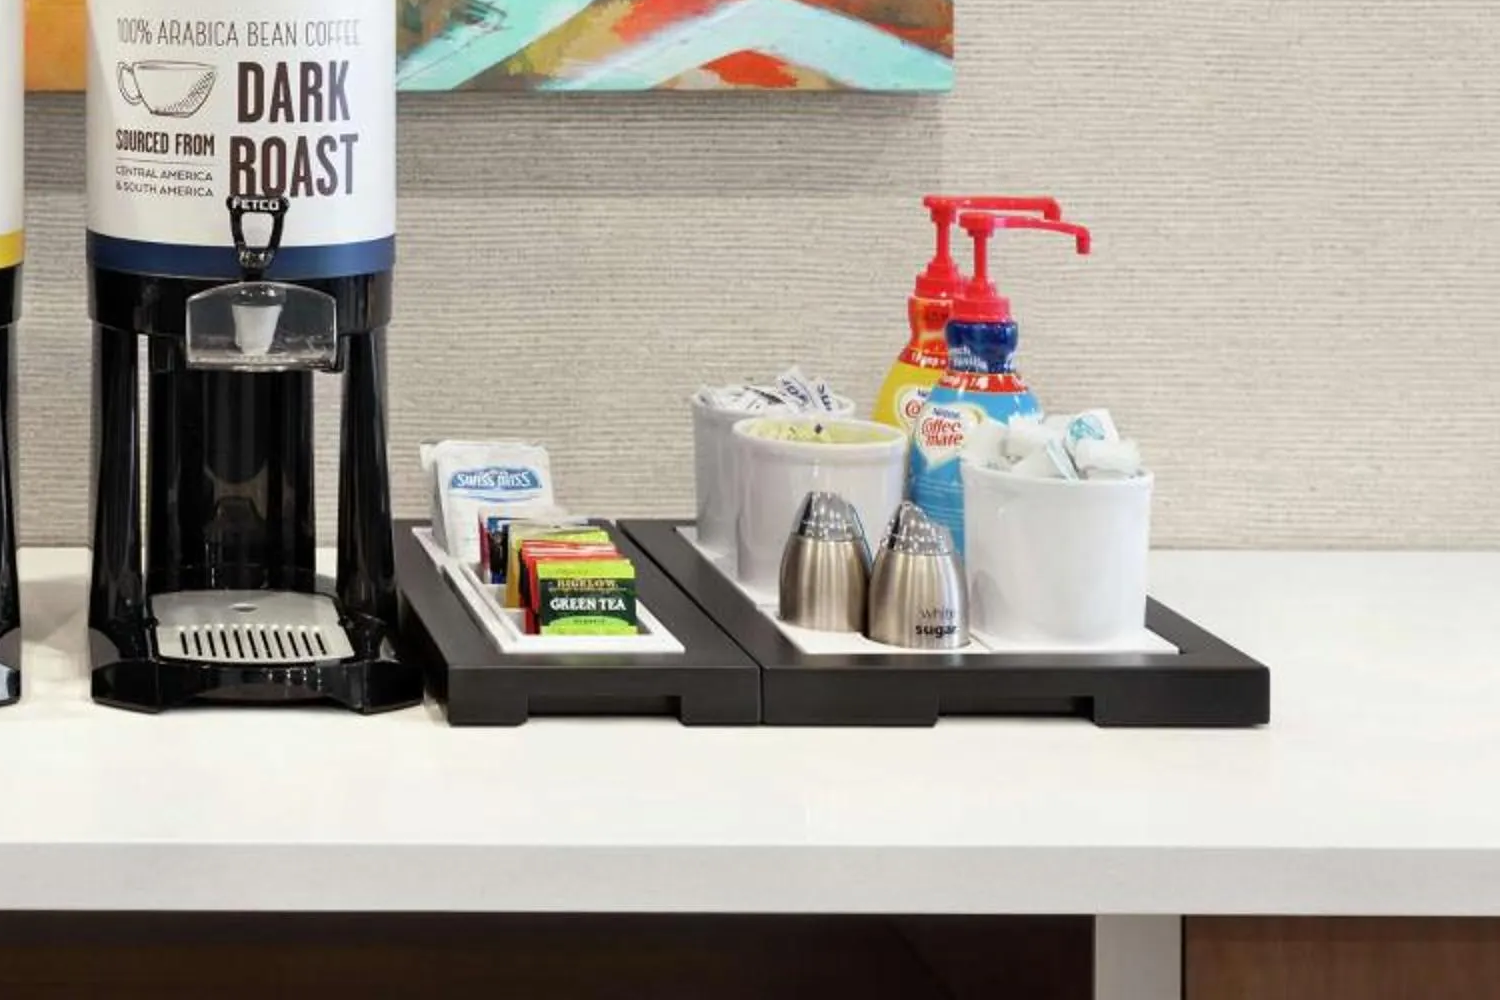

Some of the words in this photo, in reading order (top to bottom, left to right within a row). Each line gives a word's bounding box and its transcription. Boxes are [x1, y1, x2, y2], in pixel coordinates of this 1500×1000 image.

[117, 18, 152, 45] 100%
[157, 19, 239, 47] ARABICA
[247, 20, 297, 47] BEAN
[304, 19, 360, 47] COFFEE
[237, 60, 350, 124] DARK
[116, 129, 169, 154] SOURCED
[175, 133, 215, 156] FROM
[116, 165, 157, 178] CENTRAL
[160, 170, 213, 182] AMERICA
[229, 133, 358, 198] ROAST
[123, 182, 157, 194] SOUTH
[160, 185, 213, 197] AMERICA
[232, 199, 279, 211] FETCO
[550, 597, 596, 611] GREEN
[599, 597, 627, 611] TEA
[915, 625, 956, 639] sugar
